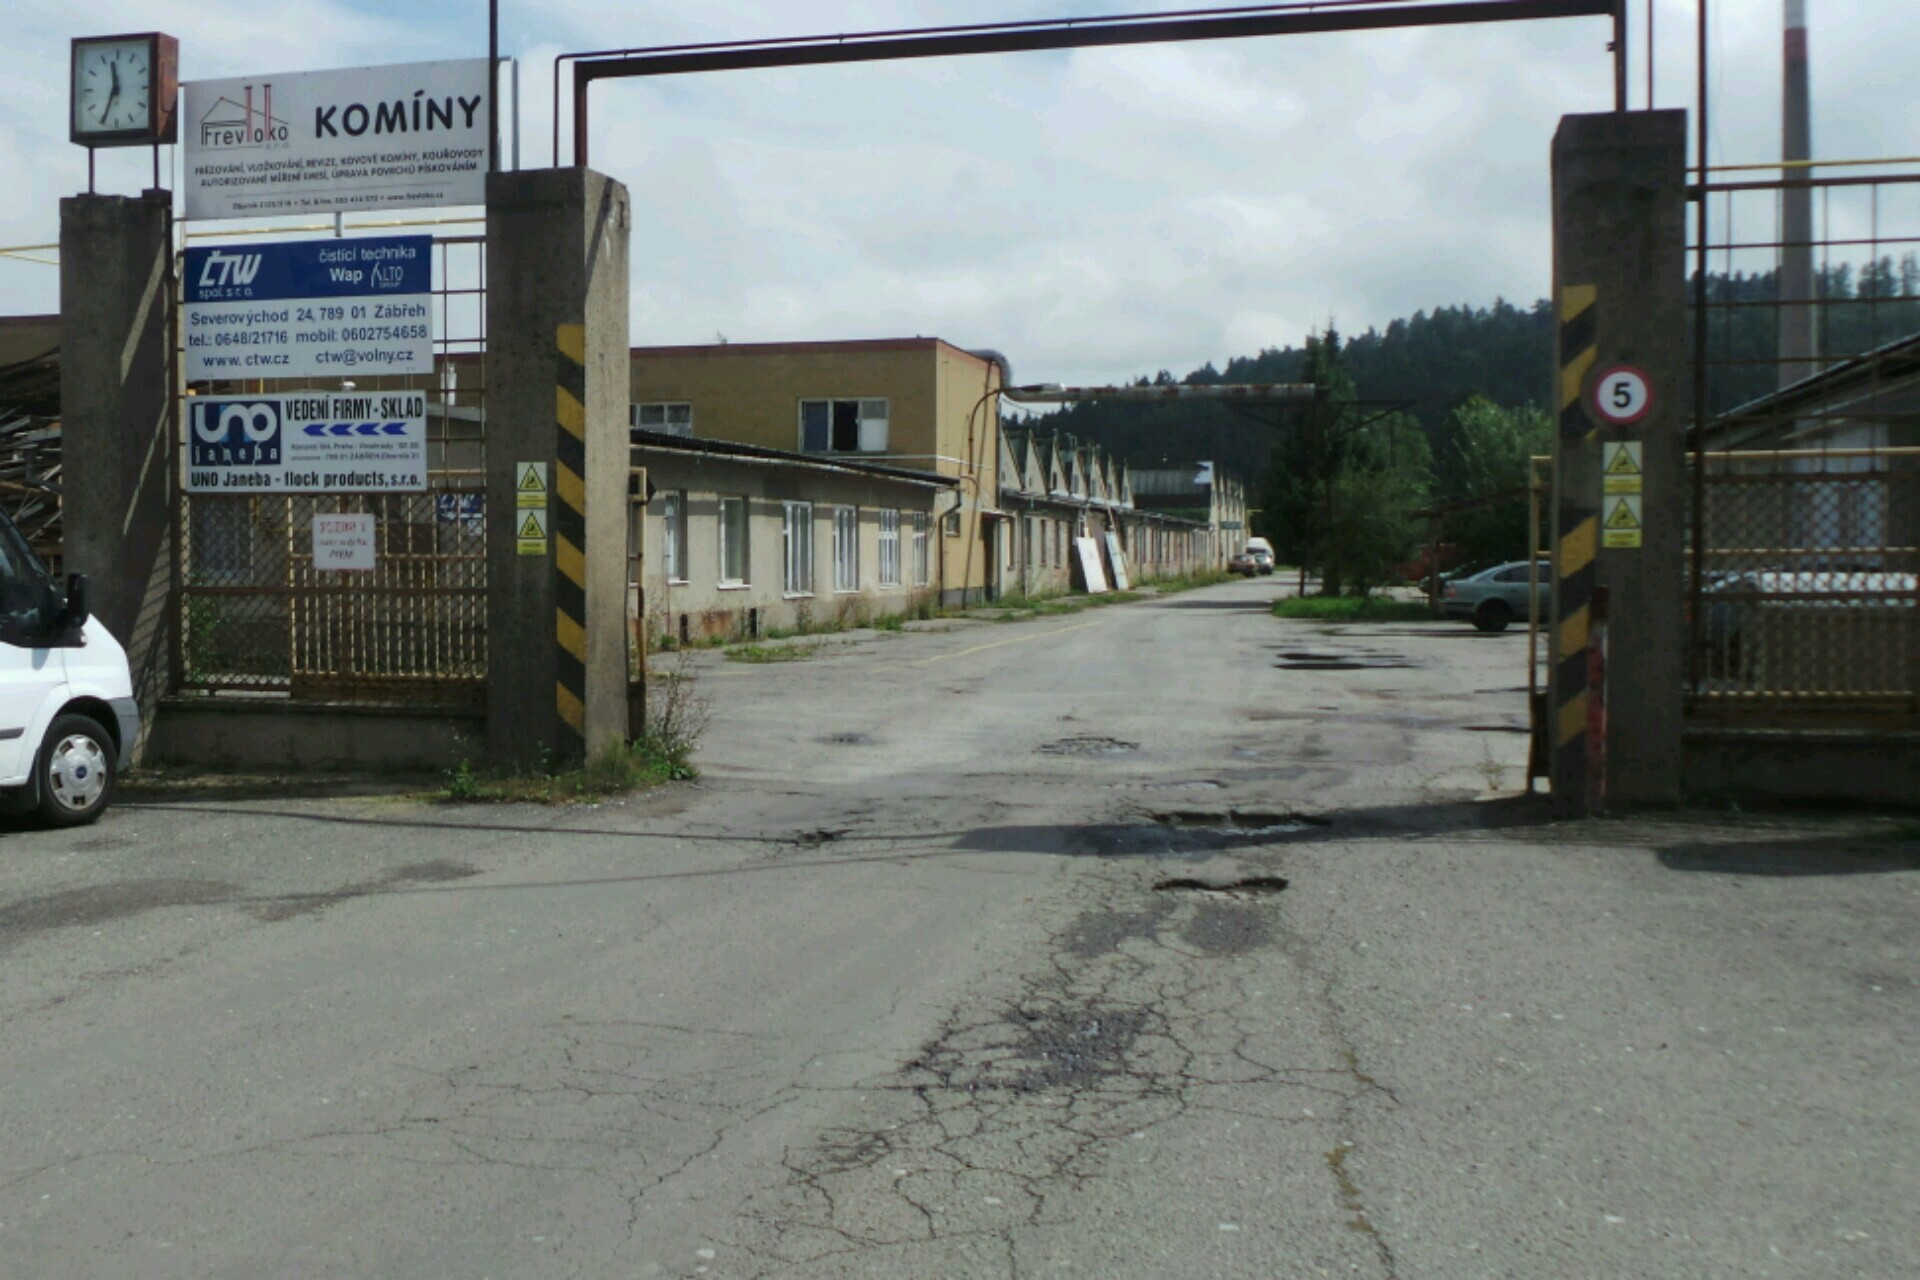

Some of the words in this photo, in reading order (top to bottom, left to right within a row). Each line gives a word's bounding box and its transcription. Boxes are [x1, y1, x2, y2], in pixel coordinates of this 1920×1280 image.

[315, 89, 481, 139] KOMÍNY
[361, 244, 416, 261] technika
[199, 250, 262, 287] ČTW
[329, 267, 363, 285] Wap
[191, 309, 289, 327] Severovýchod
[319, 306, 344, 320] 789
[351, 305, 367, 319] 01
[375, 303, 426, 319] Zábřeh
[215, 331, 288, 346] 0648/21716
[296, 328, 338, 343] mobil:
[341, 325, 428, 341] 0602754658
[315, 347, 414, 366] ctw@volny.cz
[1612, 381, 1632, 409] 5
[286, 394, 329, 421] VEDENÍ
[191, 471, 218, 492] UNO
[223, 471, 271, 492] Janeba
